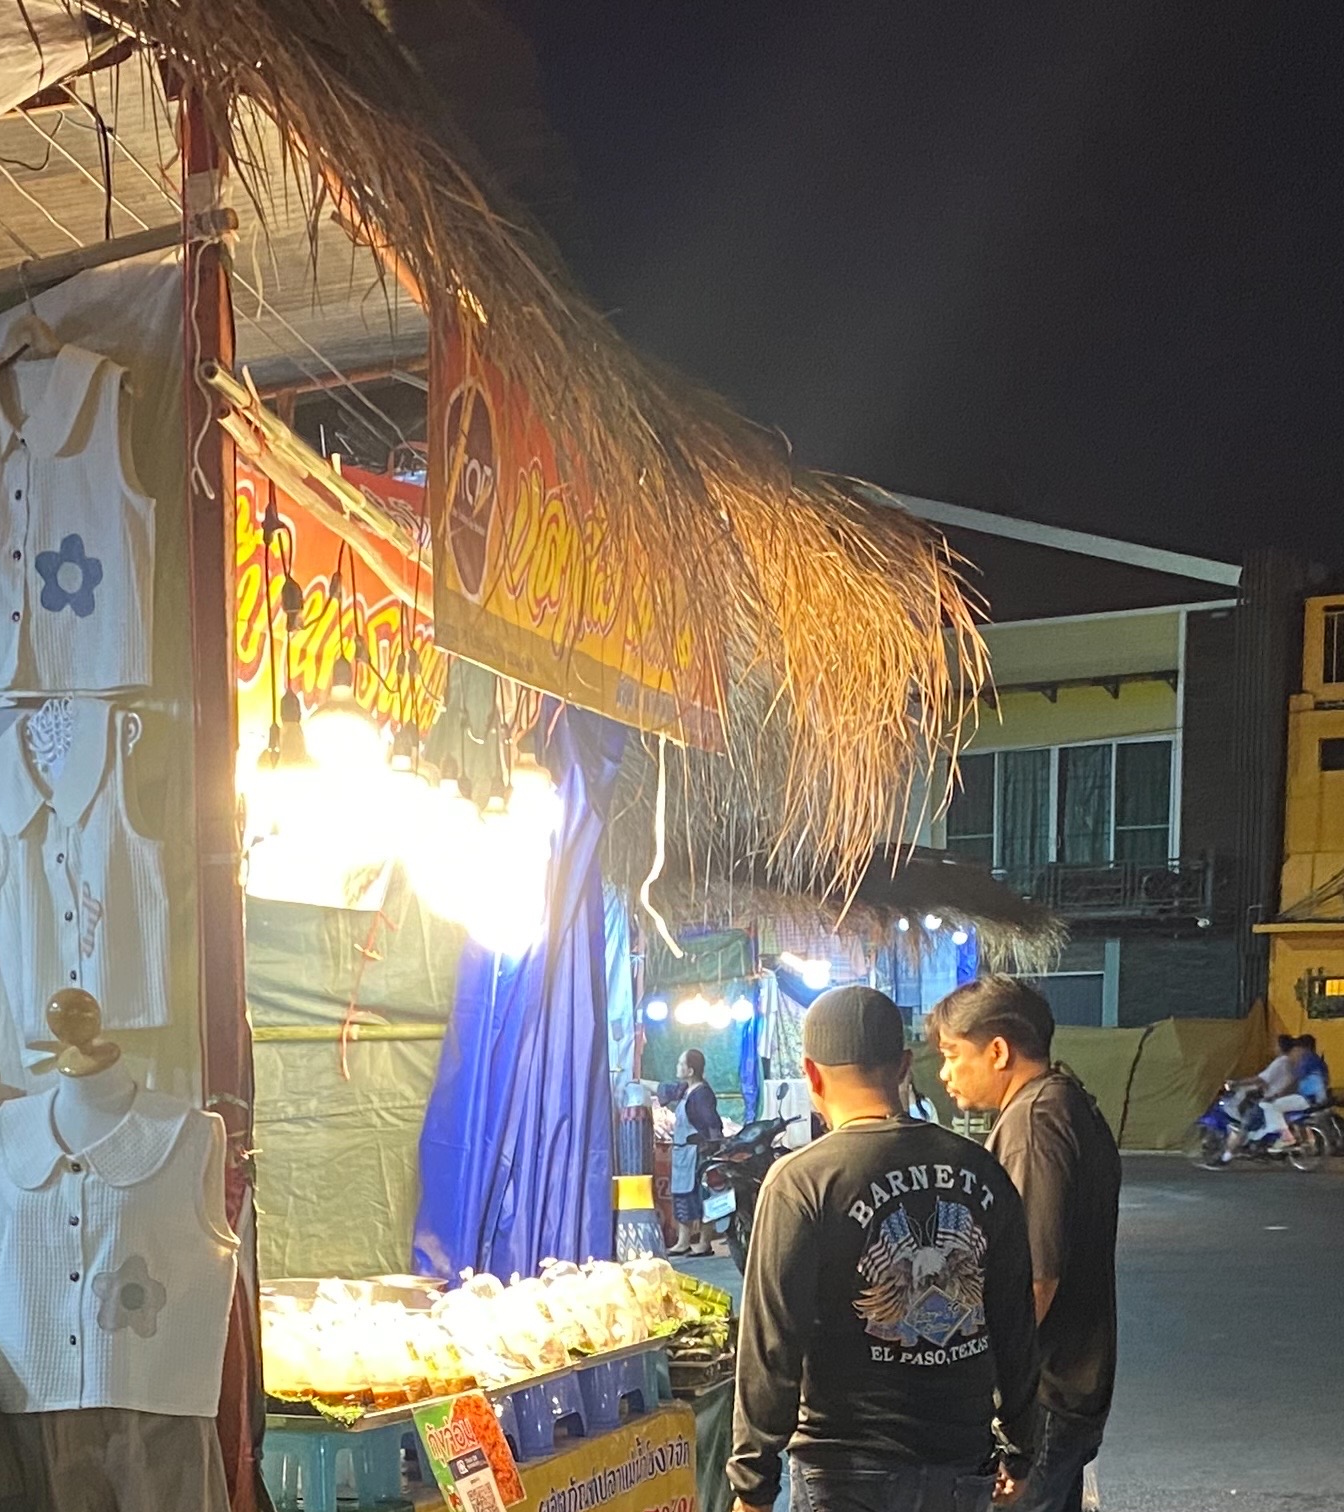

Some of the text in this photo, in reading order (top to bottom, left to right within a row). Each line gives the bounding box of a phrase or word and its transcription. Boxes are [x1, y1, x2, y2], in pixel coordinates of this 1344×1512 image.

[848, 1163, 994, 1229] BARNETT
[870, 1335, 990, 1367] EL PASO, TEXAS
